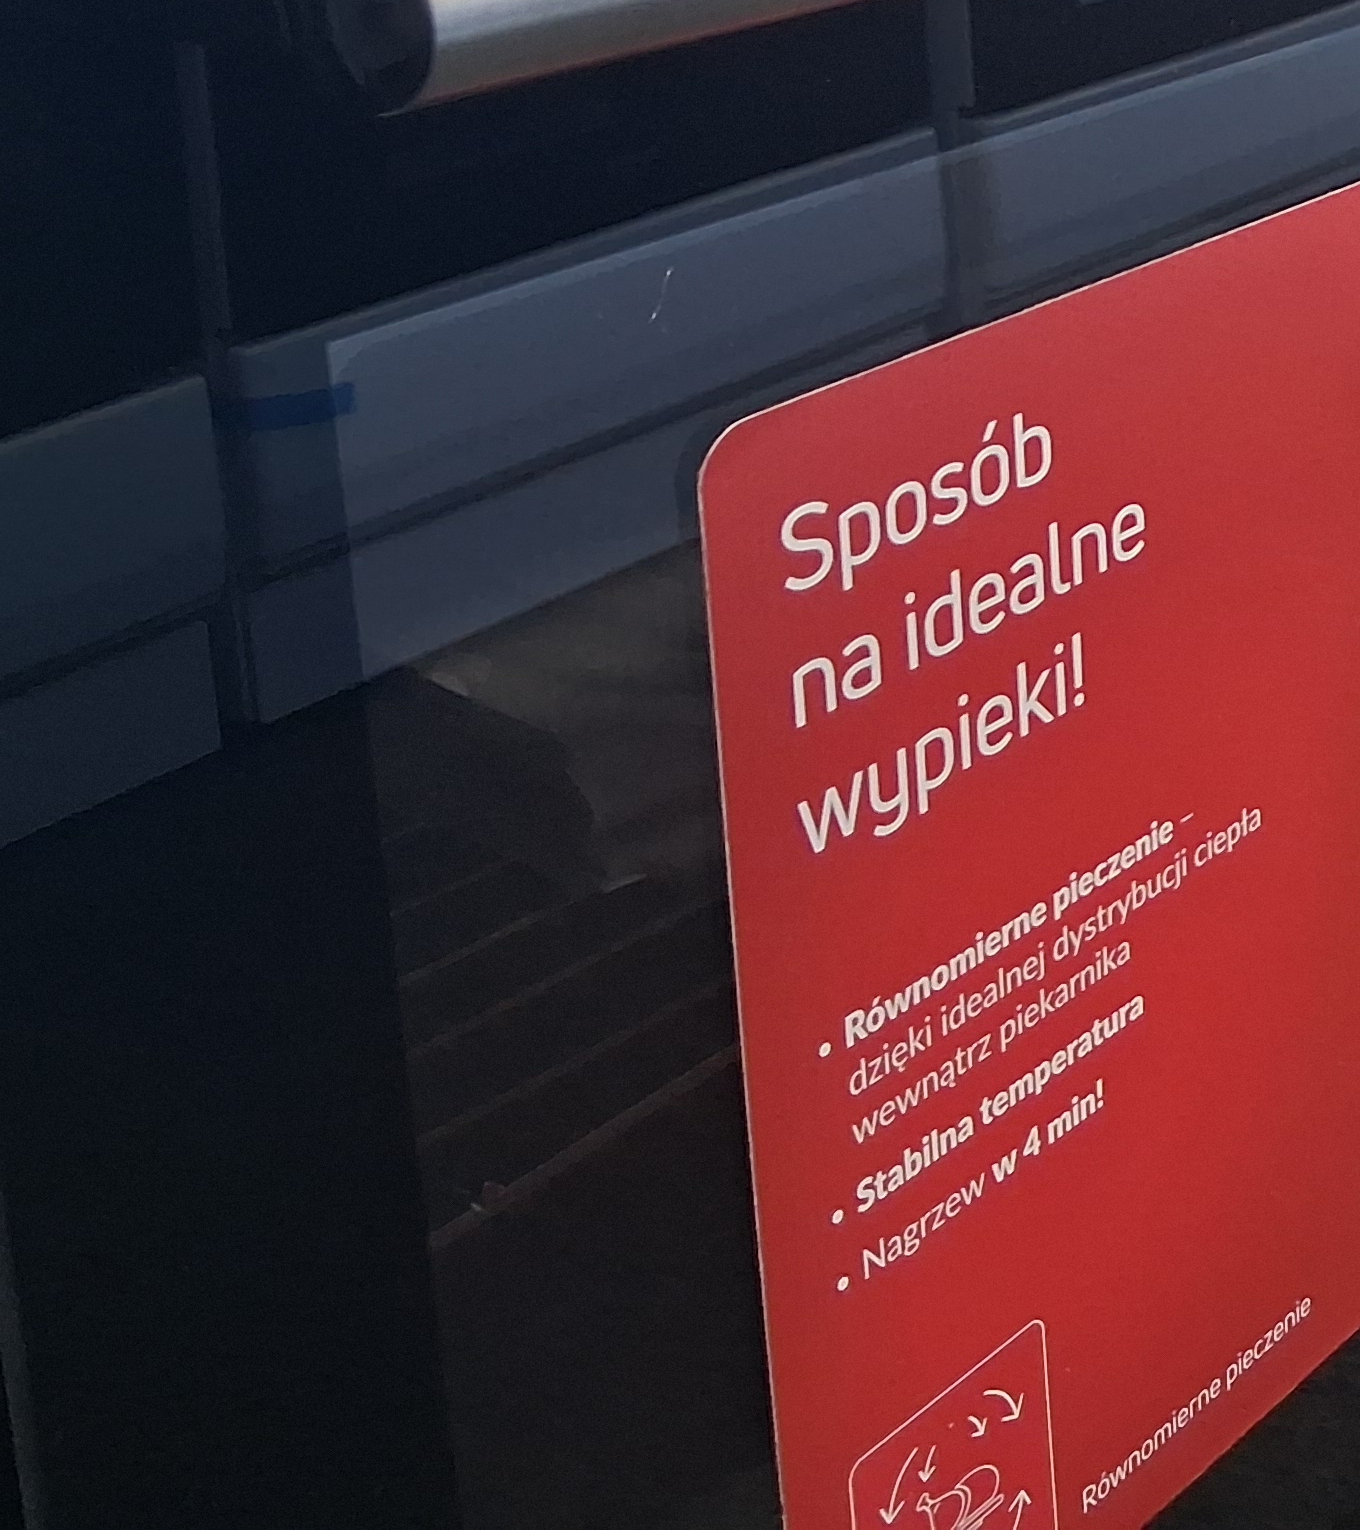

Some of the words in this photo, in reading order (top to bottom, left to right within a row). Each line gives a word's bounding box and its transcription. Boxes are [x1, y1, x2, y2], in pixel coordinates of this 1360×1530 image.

[780, 412, 1053, 591] Sposób
[791, 633, 882, 729] na
[903, 503, 1147, 670] idealne
[796, 632, 1086, 853] wypieki!
[843, 900, 1048, 1048] Równomierne
[1052, 820, 1174, 921] pieczenie
[849, 1016, 932, 1096] dzięki
[941, 942, 1046, 1037] idealnej
[1053, 849, 1189, 962] dystrybucji
[1193, 806, 1263, 869] ciepła
[851, 1033, 993, 1145] wewnątrz
[1000, 940, 1132, 1053] piekarnika
[855, 1114, 975, 1214] Stabilna
[979, 995, 1145, 1127] temperatura
[861, 1171, 986, 1280] Nagrzew
[991, 1147, 1018, 1184] w
[1022, 1125, 1042, 1158] 4
[1046, 1078, 1106, 1146] min!
[1081, 1374, 1222, 1515] Równomierne
[1225, 1294, 1313, 1391] pieczenie
